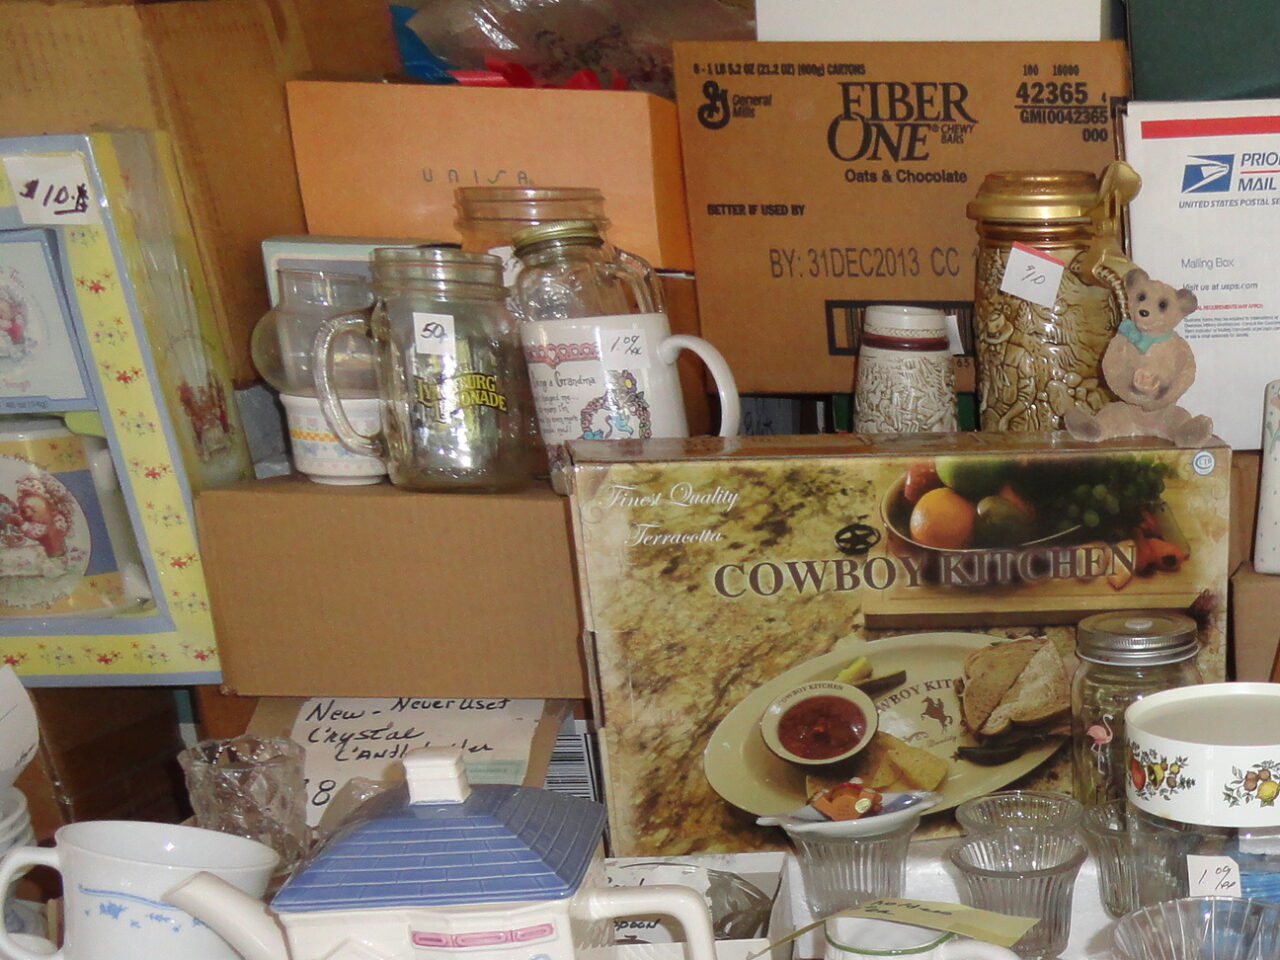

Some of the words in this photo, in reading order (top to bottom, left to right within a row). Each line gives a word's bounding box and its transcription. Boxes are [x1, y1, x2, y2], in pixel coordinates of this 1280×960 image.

[837, 81, 979, 123] FIBER
[1016, 81, 1089, 105] 42365
[827, 111, 931, 163] ONE
[940, 123, 975, 135] CHEWY
[940, 134, 965, 145] BARS
[845, 169, 878, 183] Oats
[881, 169, 893, 183] &
[896, 169, 968, 183] Chocolate
[1237, 177, 1278, 192] MAIL
[707, 204, 747, 216] BETTER
[761, 204, 788, 216] USED
[791, 204, 806, 216] BY
[1178, 200, 1209, 209] UNITED
[1210, 199, 1239, 208] STATES
[1239, 198, 1270, 207] POSTAL
[769, 248, 804, 279] BY:
[808, 247, 921, 279] 31DEC2013
[931, 247, 961, 277] CC
[1181, 258, 1214, 270] Mailing
[1216, 257, 1235, 268] Box
[1220, 282, 1258, 292] usps.com
[554, 370, 597, 388] Grandma
[599, 484, 662, 509] Finest
[668, 481, 741, 512] Quality
[624, 522, 723, 547] Terracotta
[713, 556, 924, 599] COWBOY
[939, 543, 1138, 587] KITCHEN
[306, 699, 367, 722] New
[308, 726, 425, 749] Crystal
